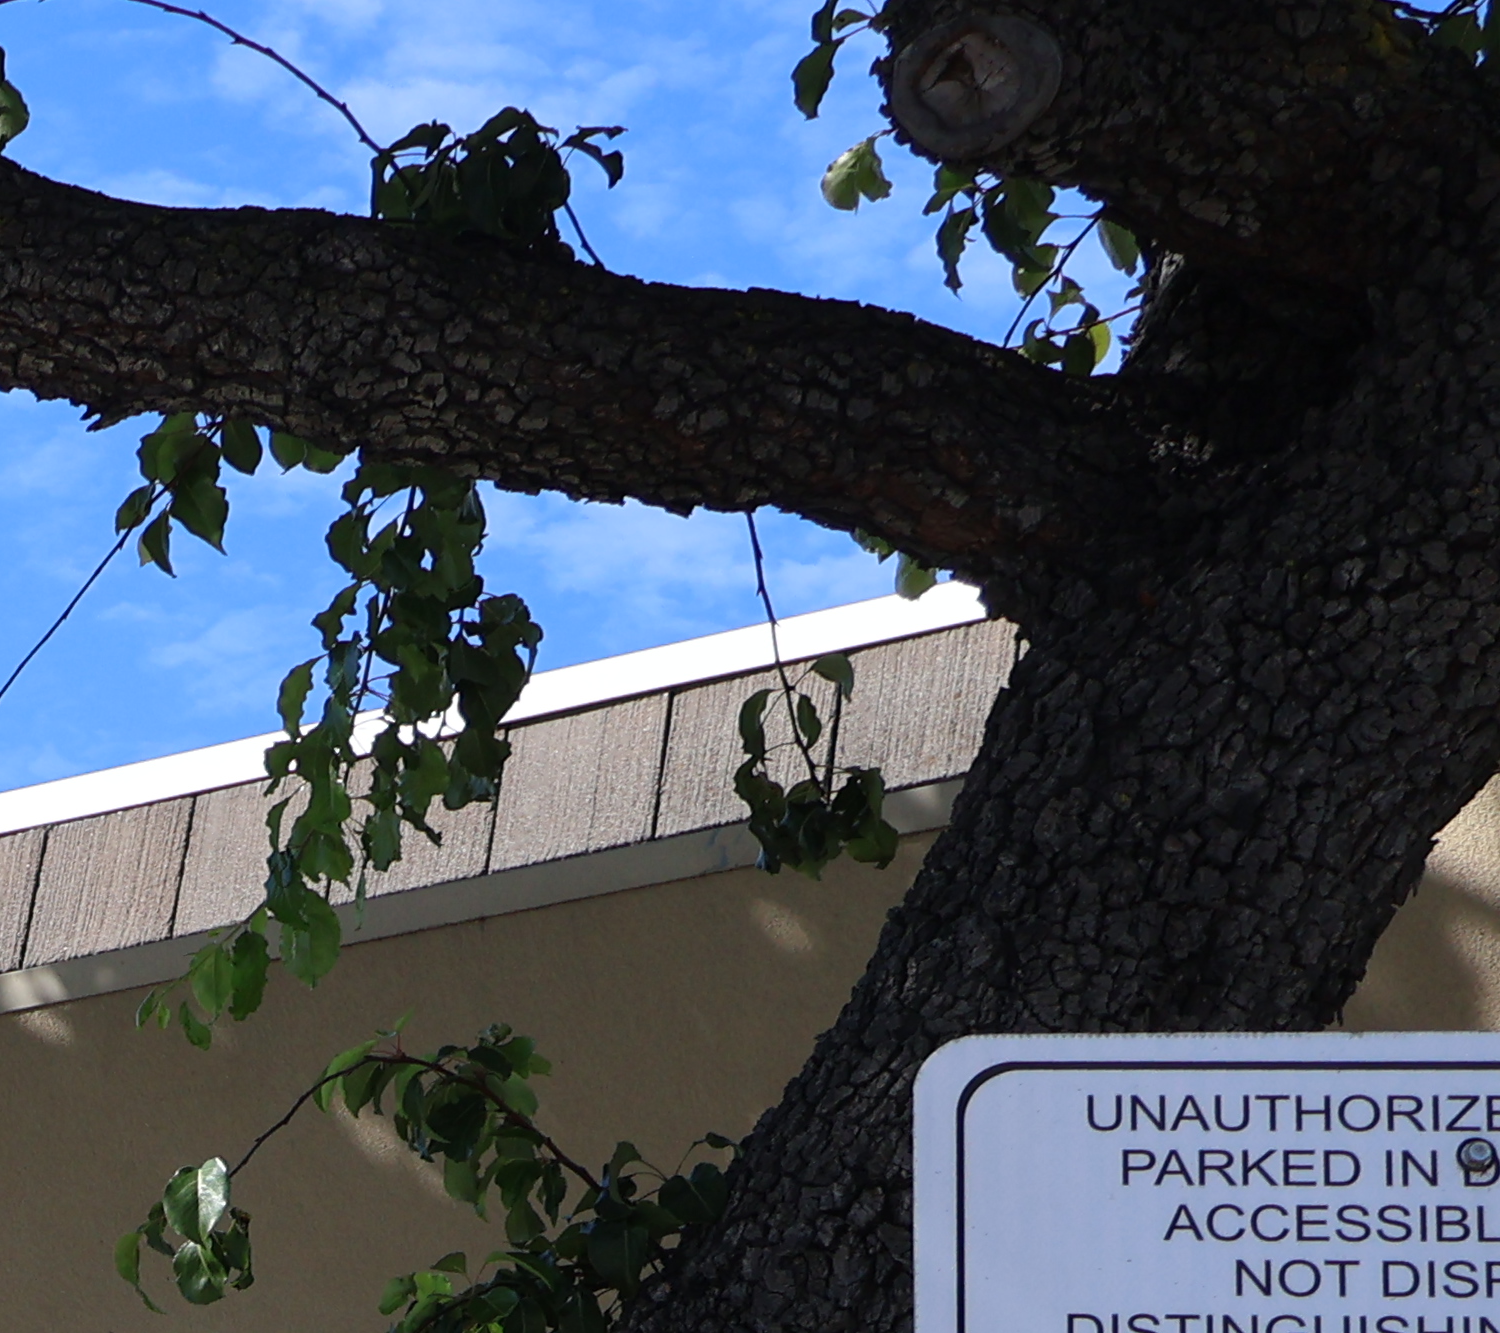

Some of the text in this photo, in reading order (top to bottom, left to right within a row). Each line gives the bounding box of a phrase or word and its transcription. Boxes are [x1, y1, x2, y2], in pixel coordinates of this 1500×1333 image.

[1121, 1150, 1362, 1187] PARKED
[1386, 1151, 1438, 1187] IN
[1164, 1204, 1500, 1242] ACCESSIBL
[1234, 1259, 1359, 1297] NOT
